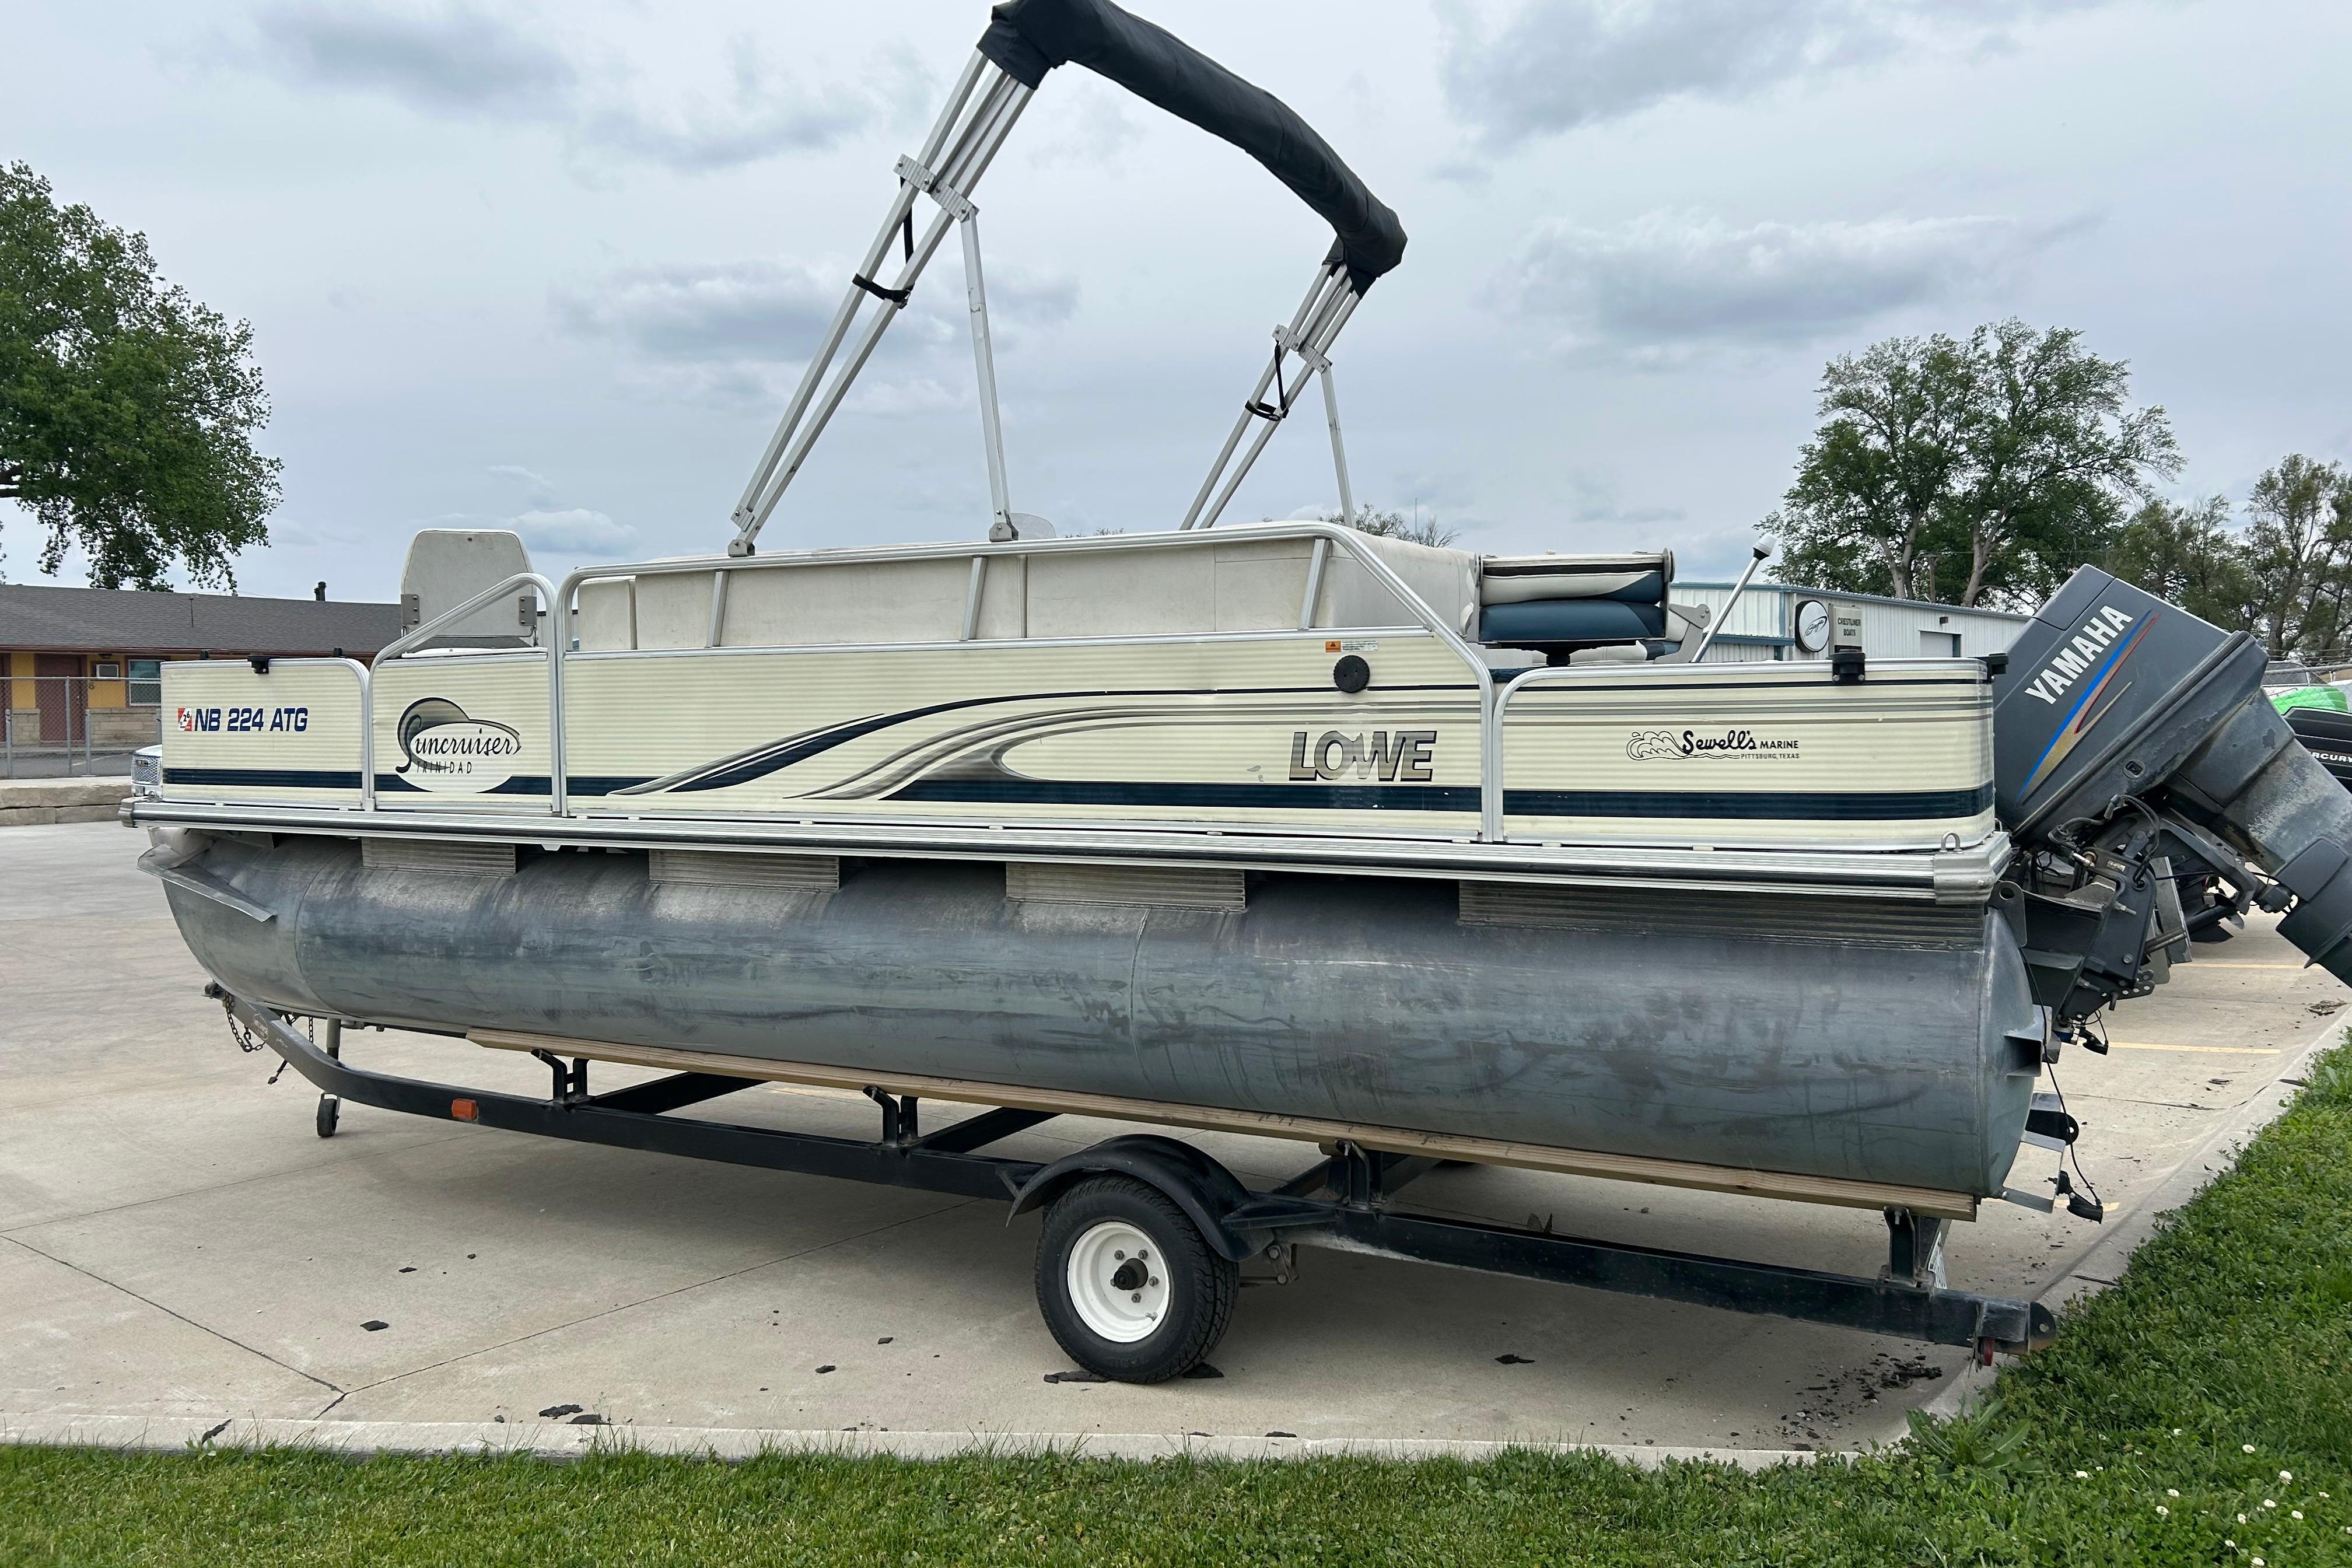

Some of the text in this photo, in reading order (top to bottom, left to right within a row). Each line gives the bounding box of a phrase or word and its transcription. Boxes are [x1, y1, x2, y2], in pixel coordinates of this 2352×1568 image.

[1838, 617, 1861, 626] CRESTLINER
[2025, 606, 2133, 705] YAMAHA
[195, 708, 308, 732] NB 224 ATG
[396, 714, 513, 774] Suncruiser
[1682, 730, 1799, 754] Sewell's MARINE
[416, 761, 473, 774] TRINIDAD
[1289, 730, 1437, 781] LOWE
[2312, 751, 2352, 763] RCURY
